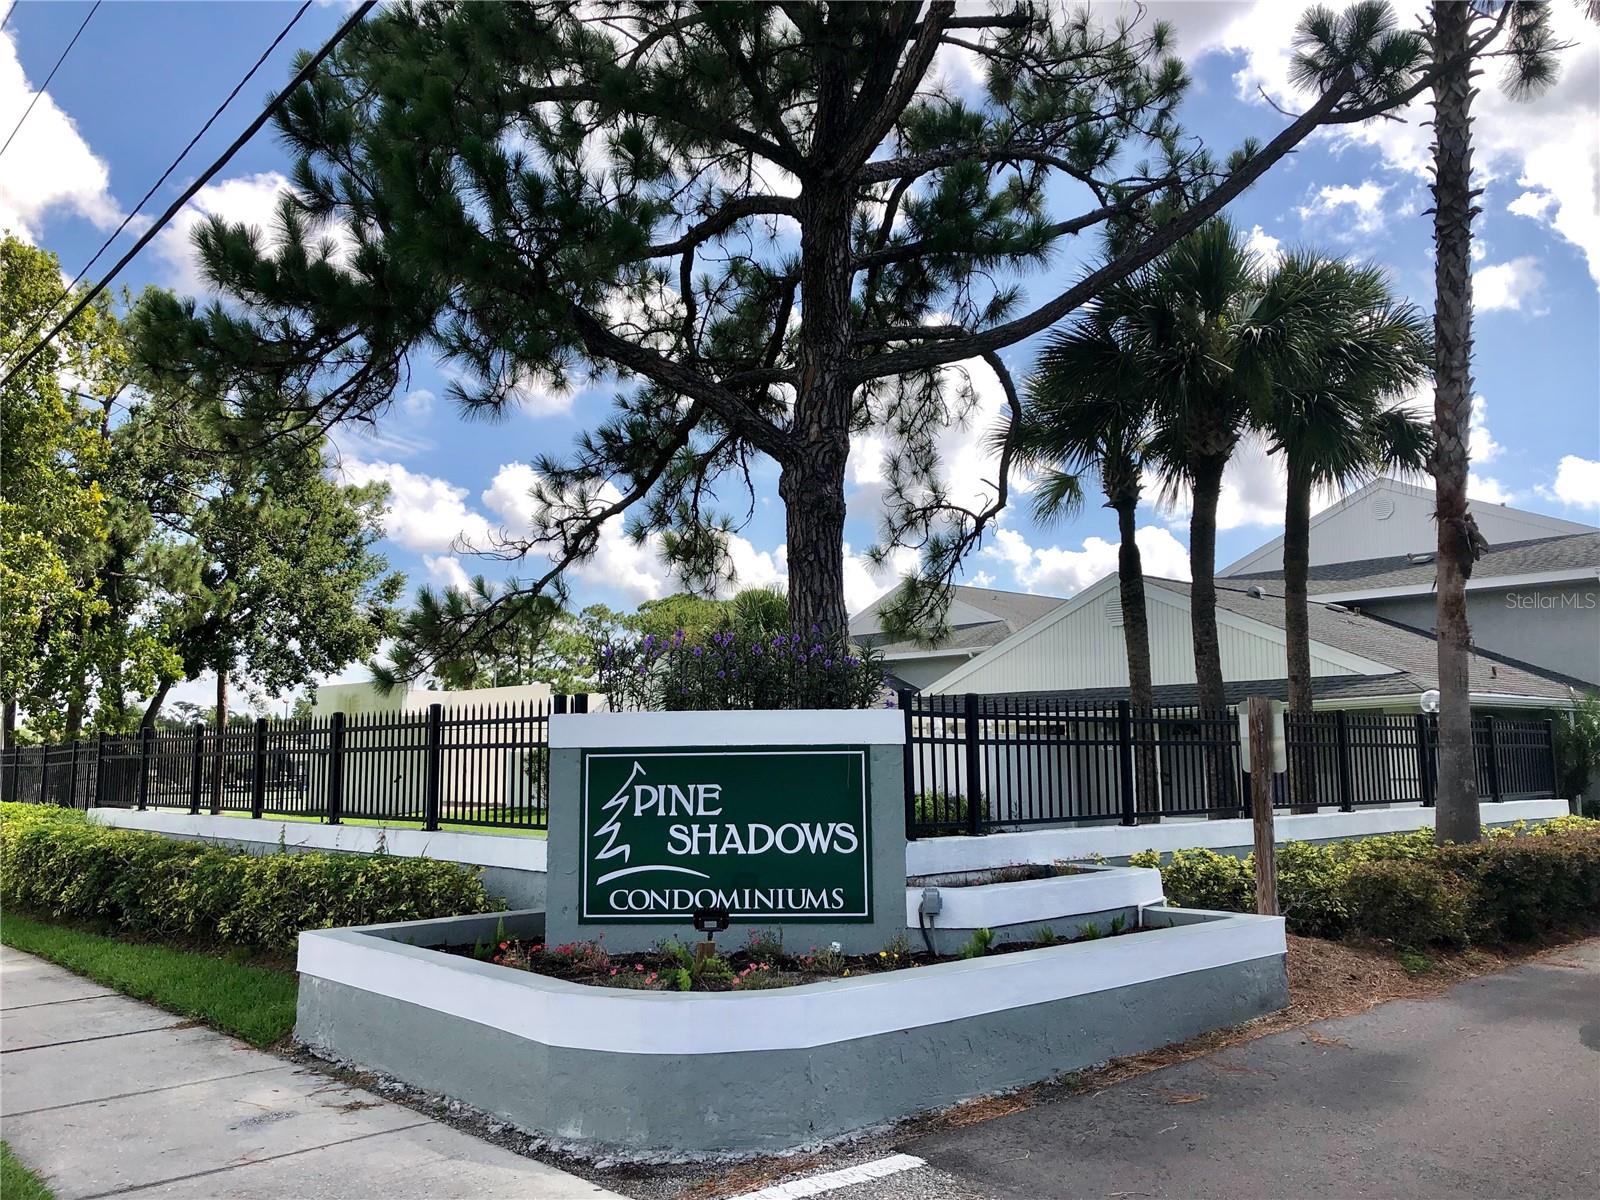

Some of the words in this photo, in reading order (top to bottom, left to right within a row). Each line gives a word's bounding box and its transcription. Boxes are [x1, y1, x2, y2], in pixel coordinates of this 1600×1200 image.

[633, 784, 722, 816] PINE
[667, 823, 858, 855] SHADOWS
[609, 888, 844, 911] CONDOMINIUMS
